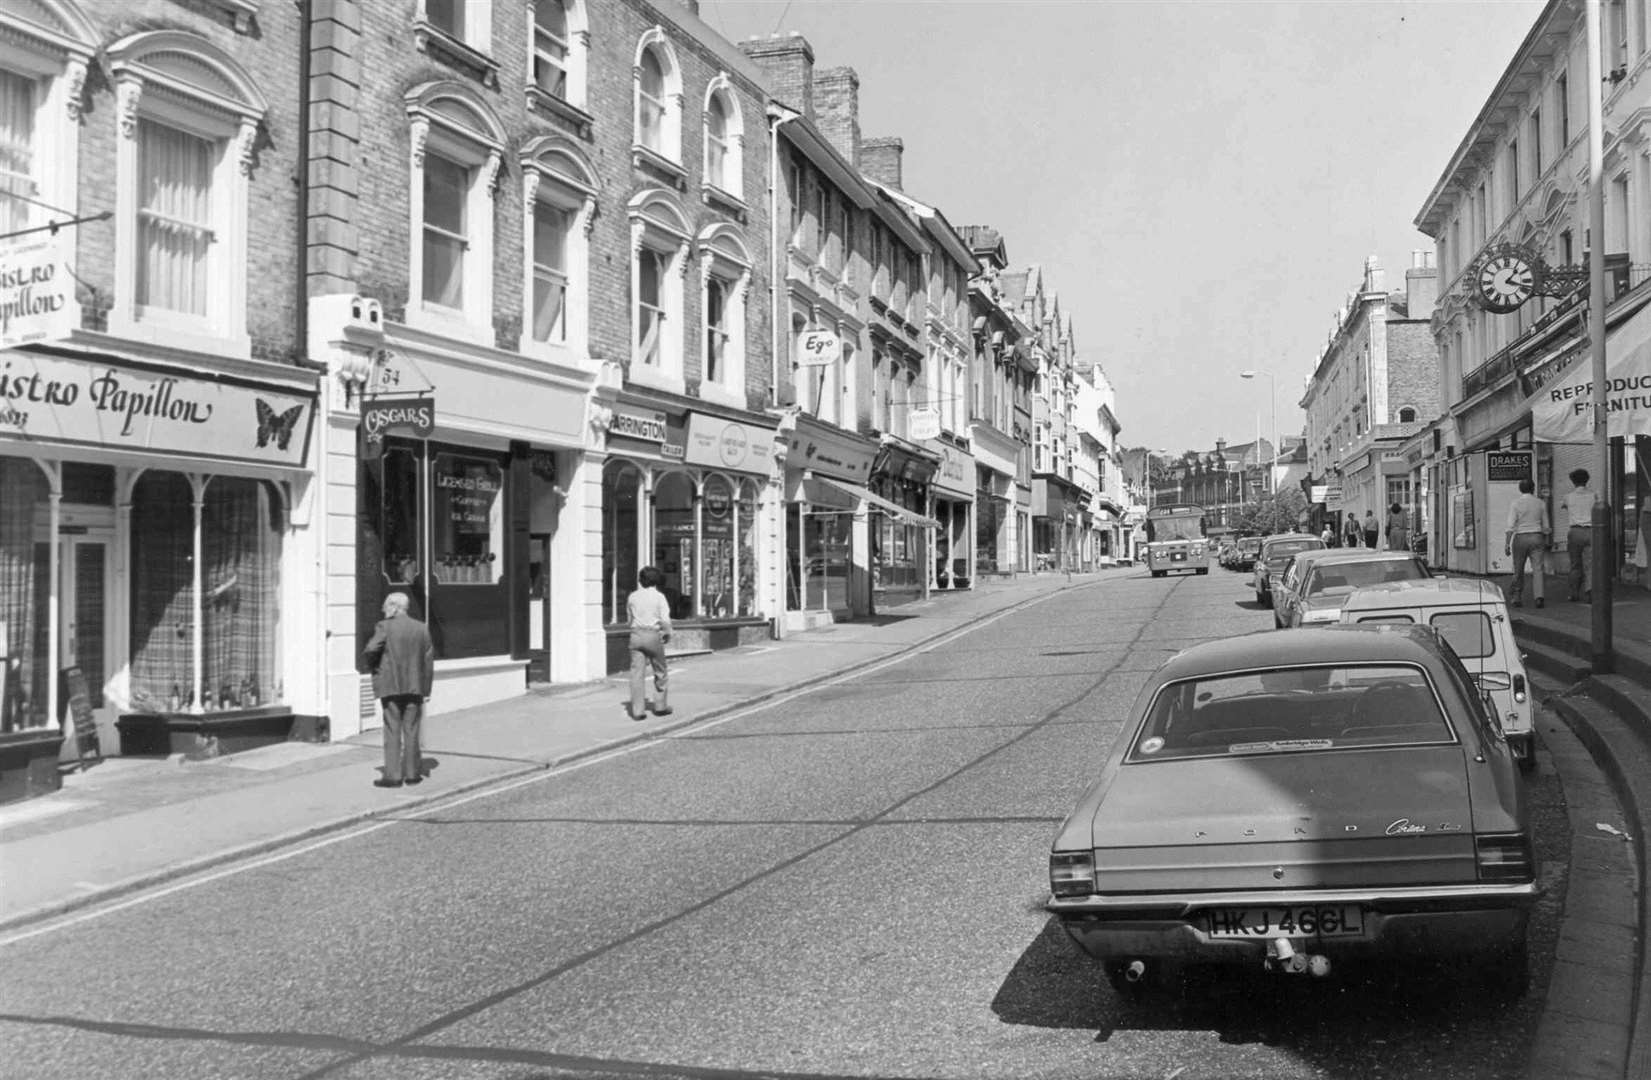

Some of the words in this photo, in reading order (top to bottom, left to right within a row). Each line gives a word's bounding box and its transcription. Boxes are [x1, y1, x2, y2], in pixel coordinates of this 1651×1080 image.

[806, 335, 833, 354] Ego
[89, 367, 212, 437] Papillon
[1490, 455, 1529, 468] DRAKES
[1211, 910, 1270, 935] HKJ
[1278, 908, 1360, 935] 466L
